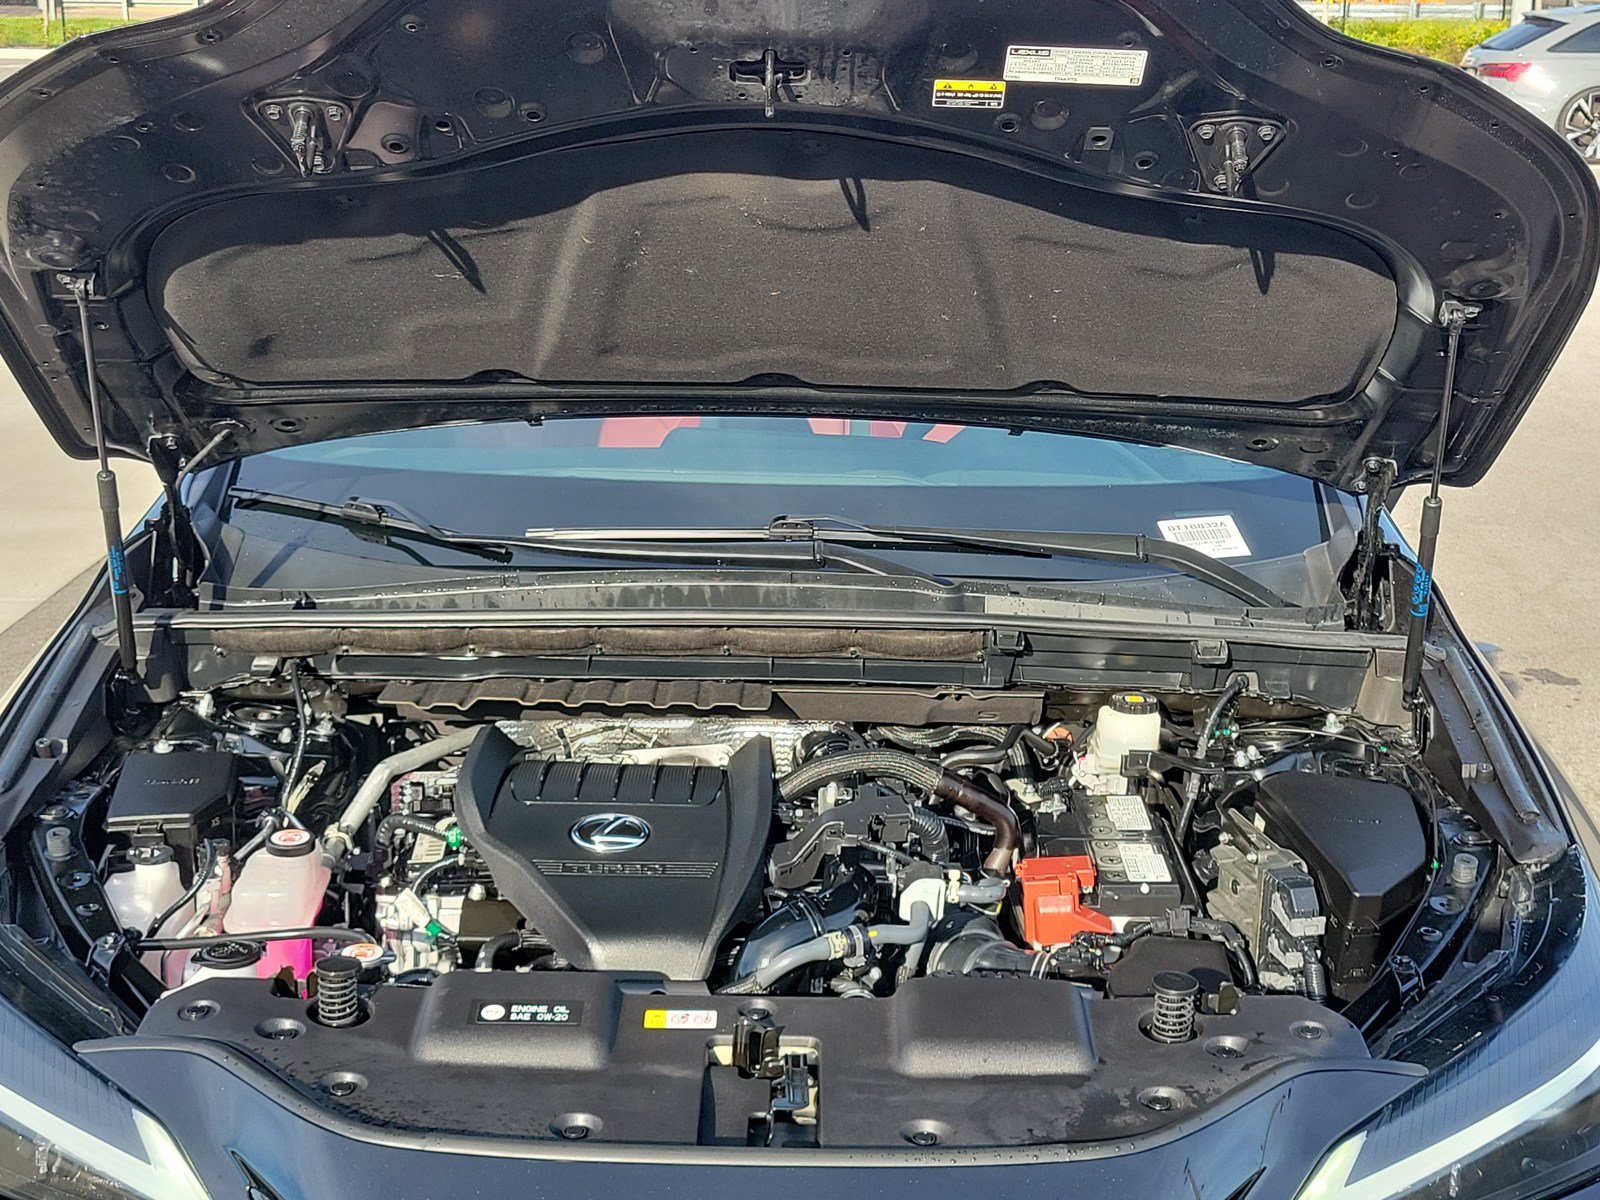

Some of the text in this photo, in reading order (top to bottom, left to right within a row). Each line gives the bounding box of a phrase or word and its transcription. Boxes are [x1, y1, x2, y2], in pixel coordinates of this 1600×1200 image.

[510, 1004, 549, 1013] ENGINE
[553, 1005, 570, 1014] OIL
[510, 1013, 531, 1021] SAE
[536, 1013, 569, 1022] 0W-20
